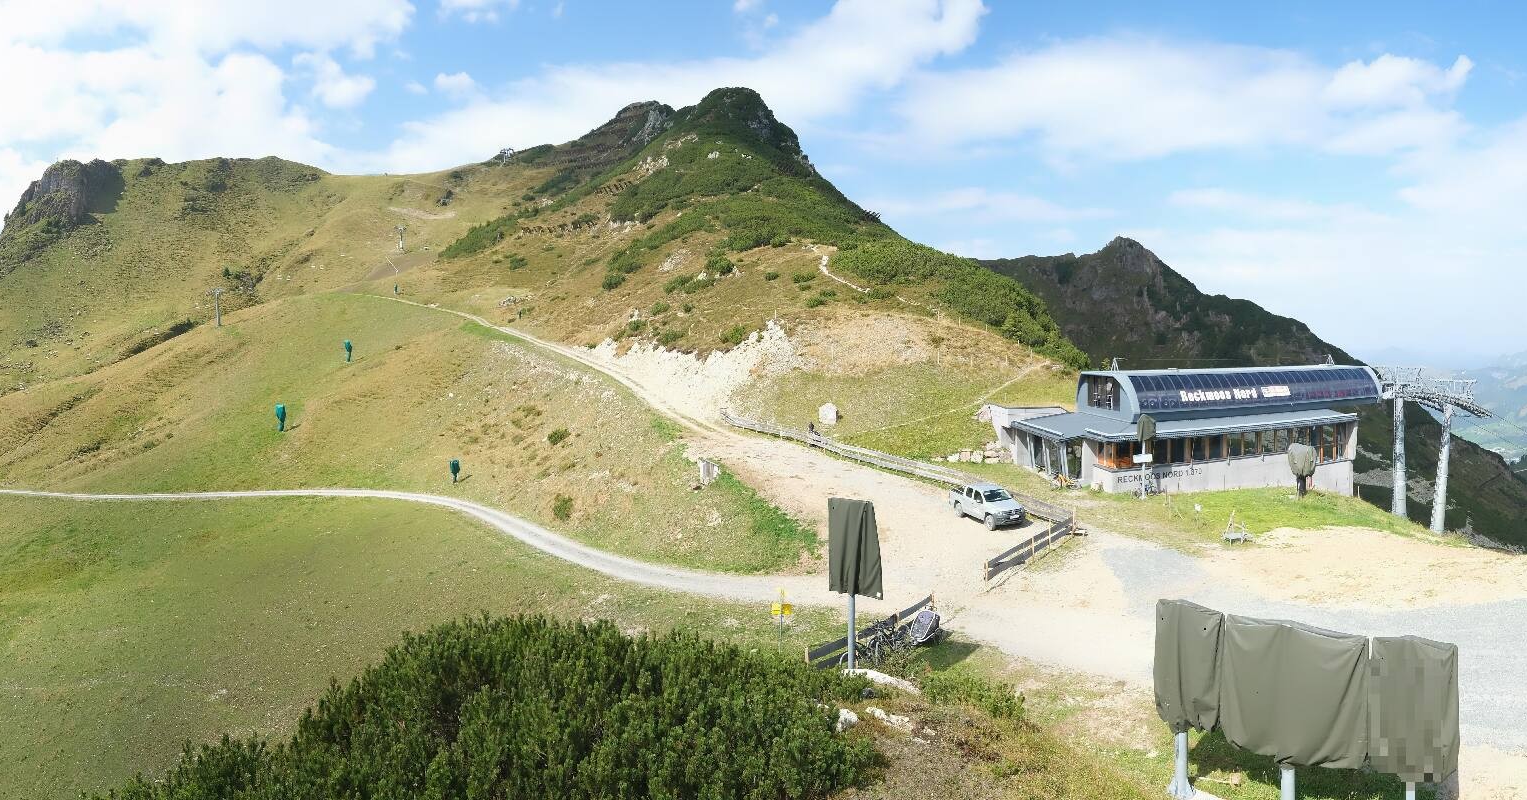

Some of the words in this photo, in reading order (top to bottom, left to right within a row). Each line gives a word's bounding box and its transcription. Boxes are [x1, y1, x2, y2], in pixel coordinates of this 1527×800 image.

[1180, 389, 1231, 402] Reckmoos
[1233, 387, 1258, 400] Nord
[1163, 469, 1184, 479] NORD
